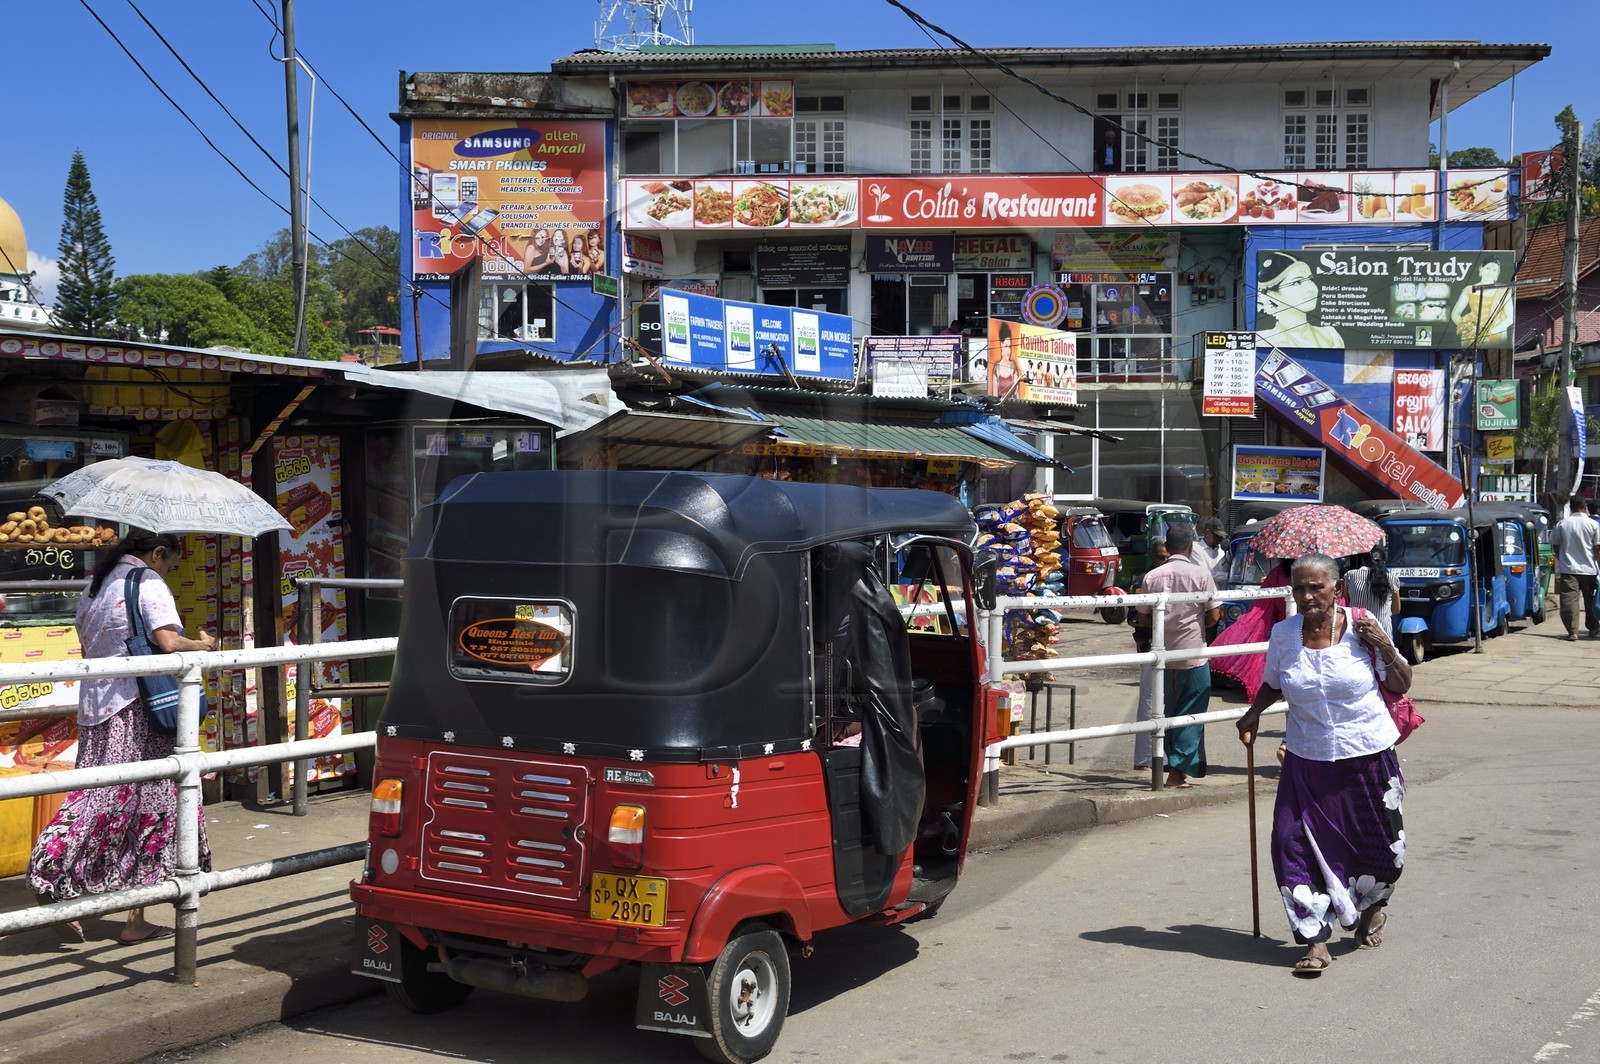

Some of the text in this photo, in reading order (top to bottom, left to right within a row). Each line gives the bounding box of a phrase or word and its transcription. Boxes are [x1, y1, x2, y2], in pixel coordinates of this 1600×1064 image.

[422, 132, 458, 140] ORIGINAL
[464, 137, 531, 149] SAMSUNG
[538, 143, 586, 156] Anycall
[449, 160, 547, 171] SMART PHONES
[903, 181, 1097, 219] Colin's Restaurant
[955, 239, 1022, 254] REGAL
[482, 256, 524, 273] obile
[980, 256, 1010, 268] Salon
[1316, 252, 1472, 281] Salon Trudy
[995, 277, 1027, 287] REGAL
[640, 322, 661, 331] SO
[730, 322, 750, 333] Telecom
[1020, 333, 1075, 357] Kavitha Tailors
[1207, 335, 1227, 345] LED
[1262, 381, 1297, 408] SAMSUNG
[1294, 409, 1315, 425] Anycall
[1480, 419, 1518, 427] FUJIFILM
[1396, 415, 1430, 433] SALO
[1293, 456, 1320, 468] Hotel
[1409, 480, 1449, 509] mobile
[1400, 569, 1414, 577] AAR
[1418, 569, 1438, 577] 1549
[468, 627, 557, 640] Queens Rest Inn
[616, 877, 639, 898] QX
[611, 900, 653, 922] 2890
[363, 958, 392, 972] BAJAJ
[654, 1011, 696, 1025] BAJAJ
